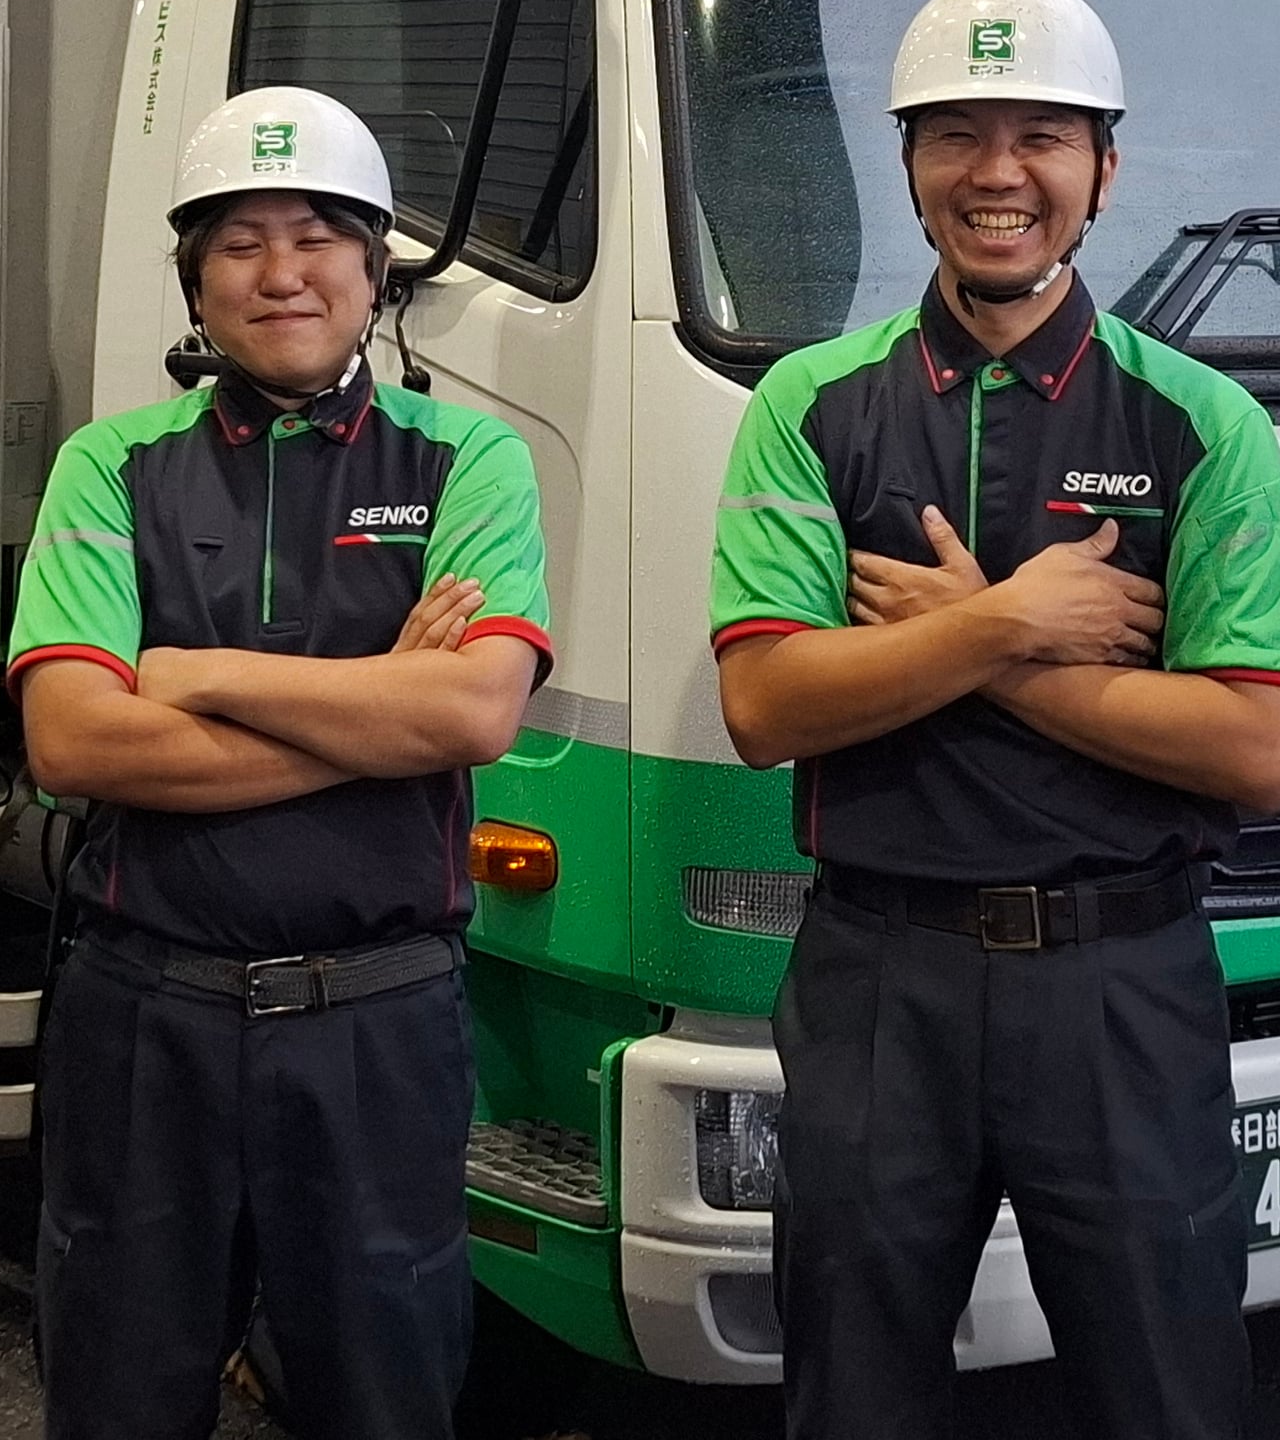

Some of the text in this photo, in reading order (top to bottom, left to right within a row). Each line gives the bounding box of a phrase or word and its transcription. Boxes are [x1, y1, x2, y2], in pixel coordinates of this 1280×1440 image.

[252, 162, 291, 173] センコ
[1062, 470, 1152, 496] SENKO
[347, 504, 430, 527] SENKO
